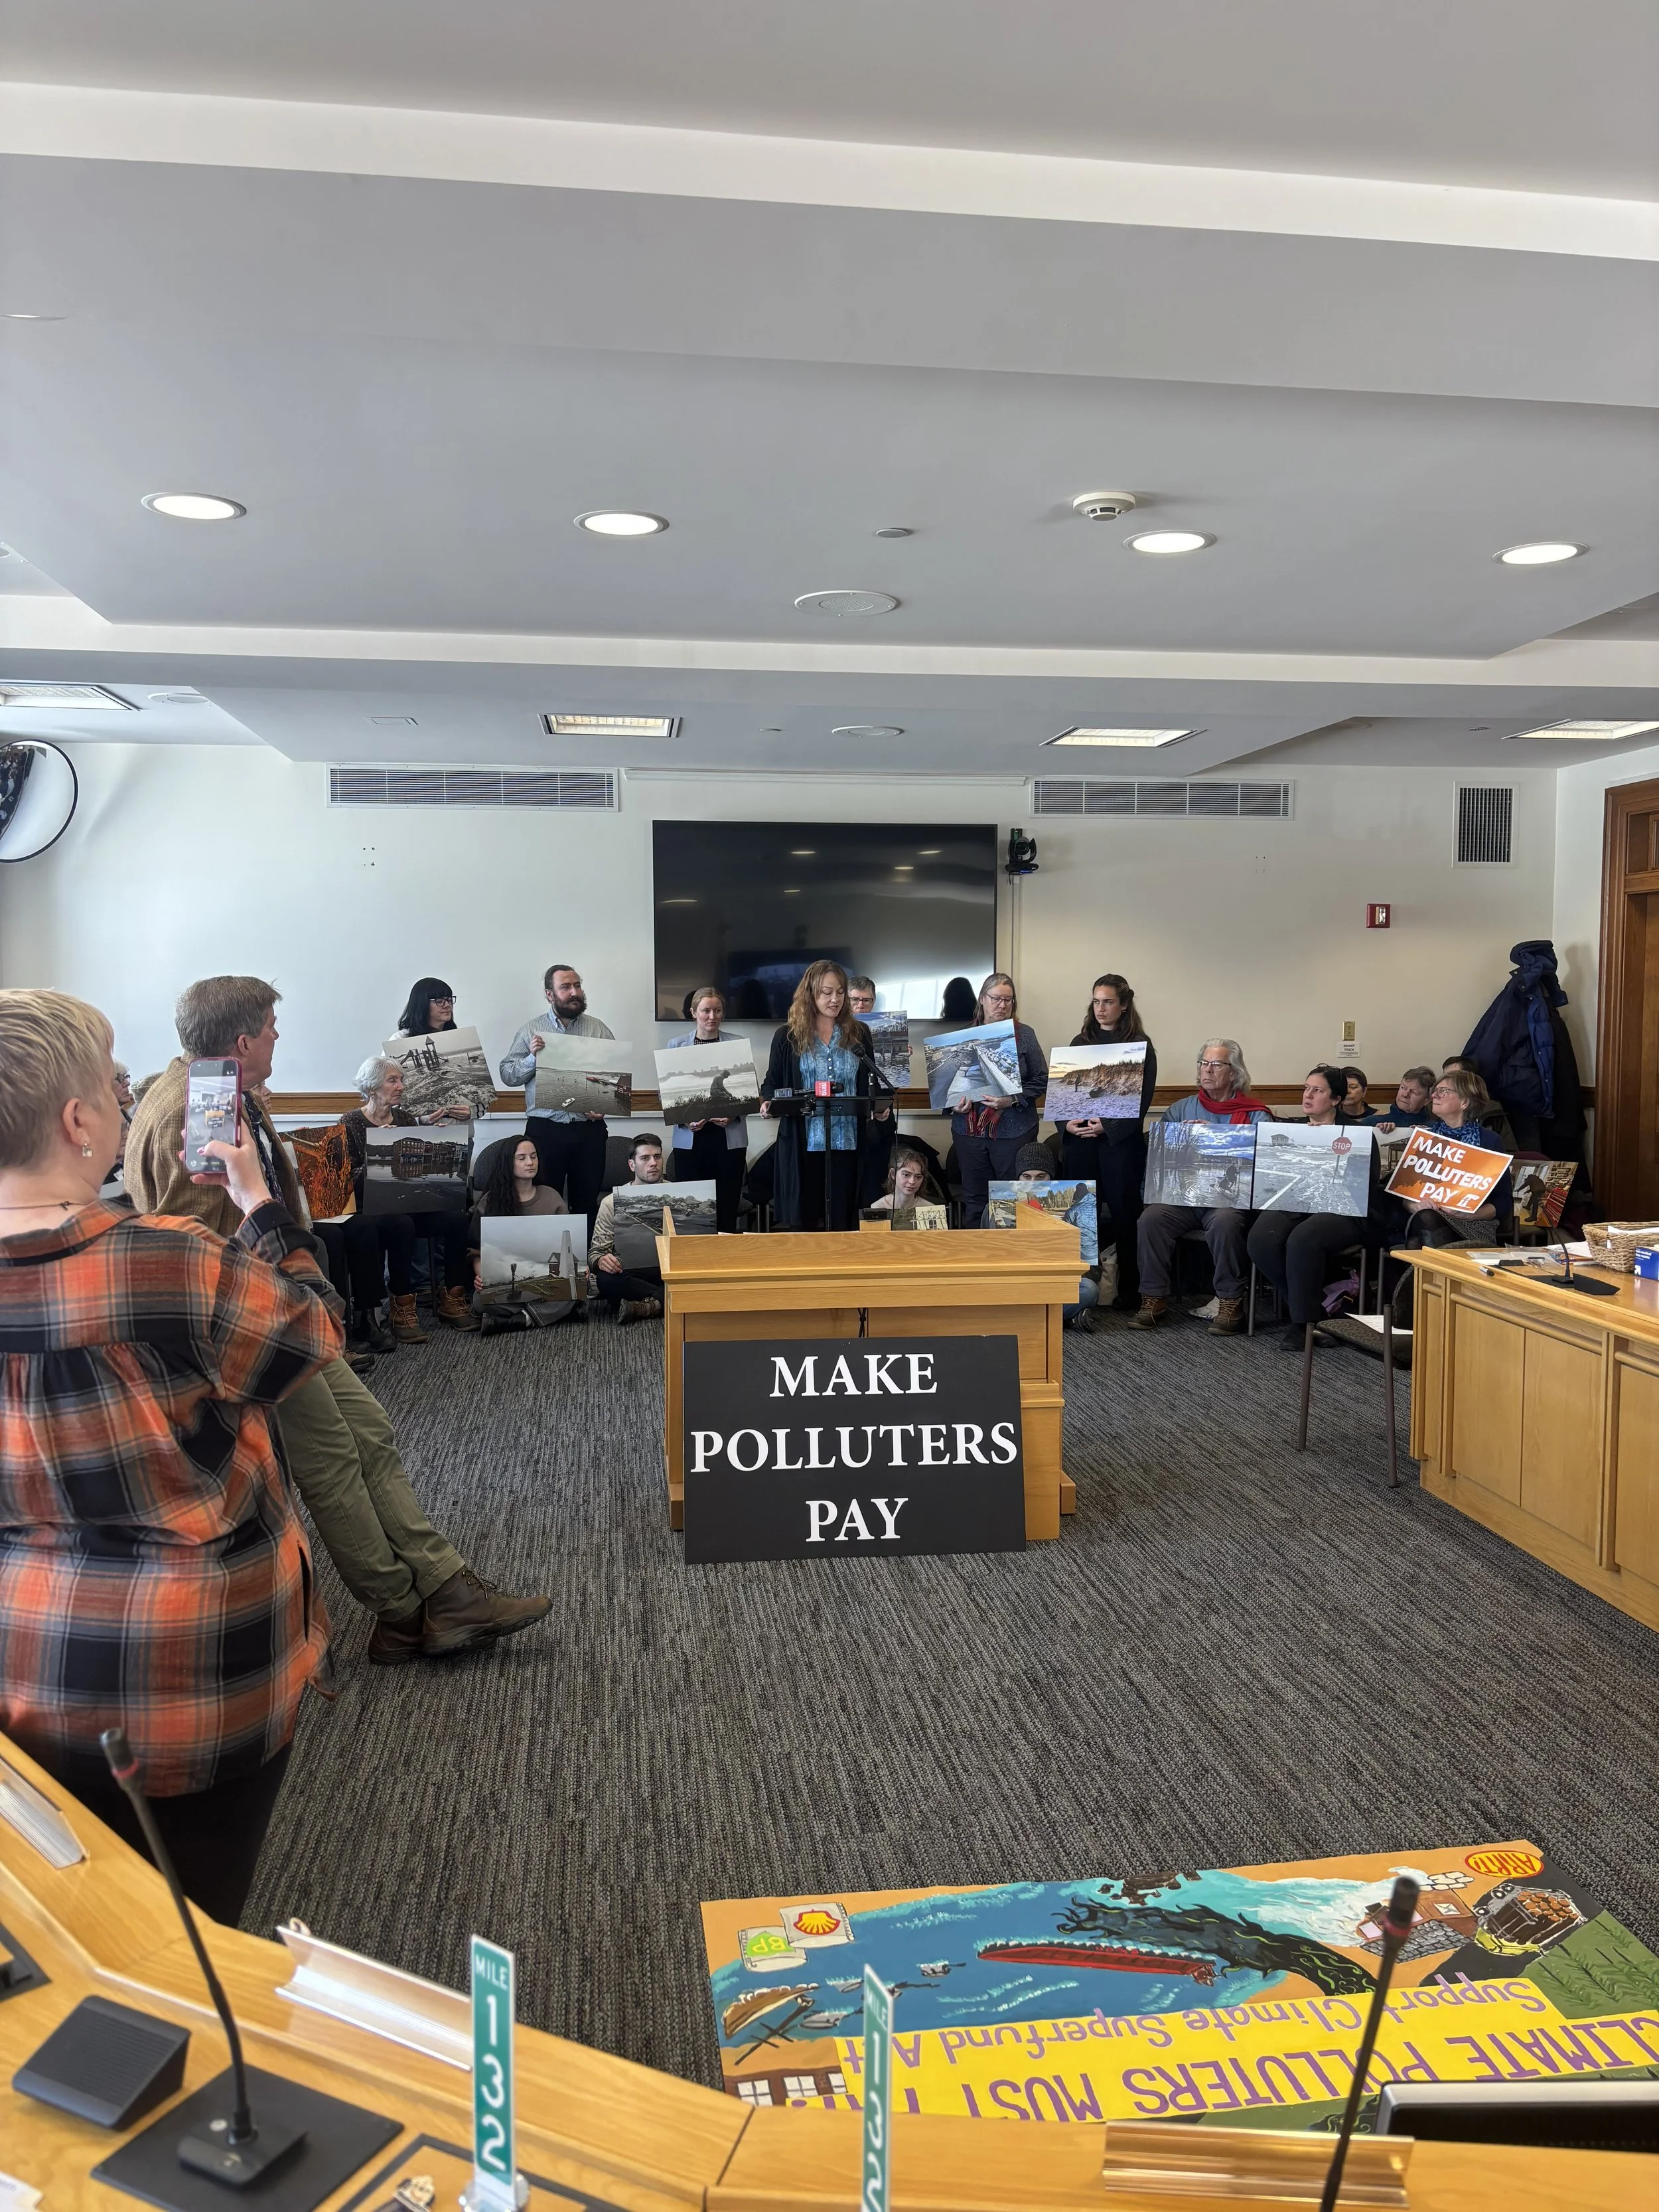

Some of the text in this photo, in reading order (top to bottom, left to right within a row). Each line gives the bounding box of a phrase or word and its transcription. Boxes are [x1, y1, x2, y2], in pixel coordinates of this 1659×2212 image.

[1333, 1142, 1351, 1150] STOP
[1412, 1136, 1467, 1163] MAKE
[1402, 1155, 1492, 1191] POLLUTERS
[1419, 1183, 1459, 1203] PAY
[769, 1353, 938, 1398] MAKE
[690, 1422, 1017, 1473] POLLUTERS
[805, 1497, 909, 1542] PAY
[753, 1937, 786, 1953] BP
[475, 1954, 509, 1990] MILE
[843, 1972, 1547, 2074] Support Climate Superfund At
[867, 1987, 887, 2031] MILE
[480, 1994, 506, 2172] 132
[1122, 2041, 1440, 2114] POLLUTERS
